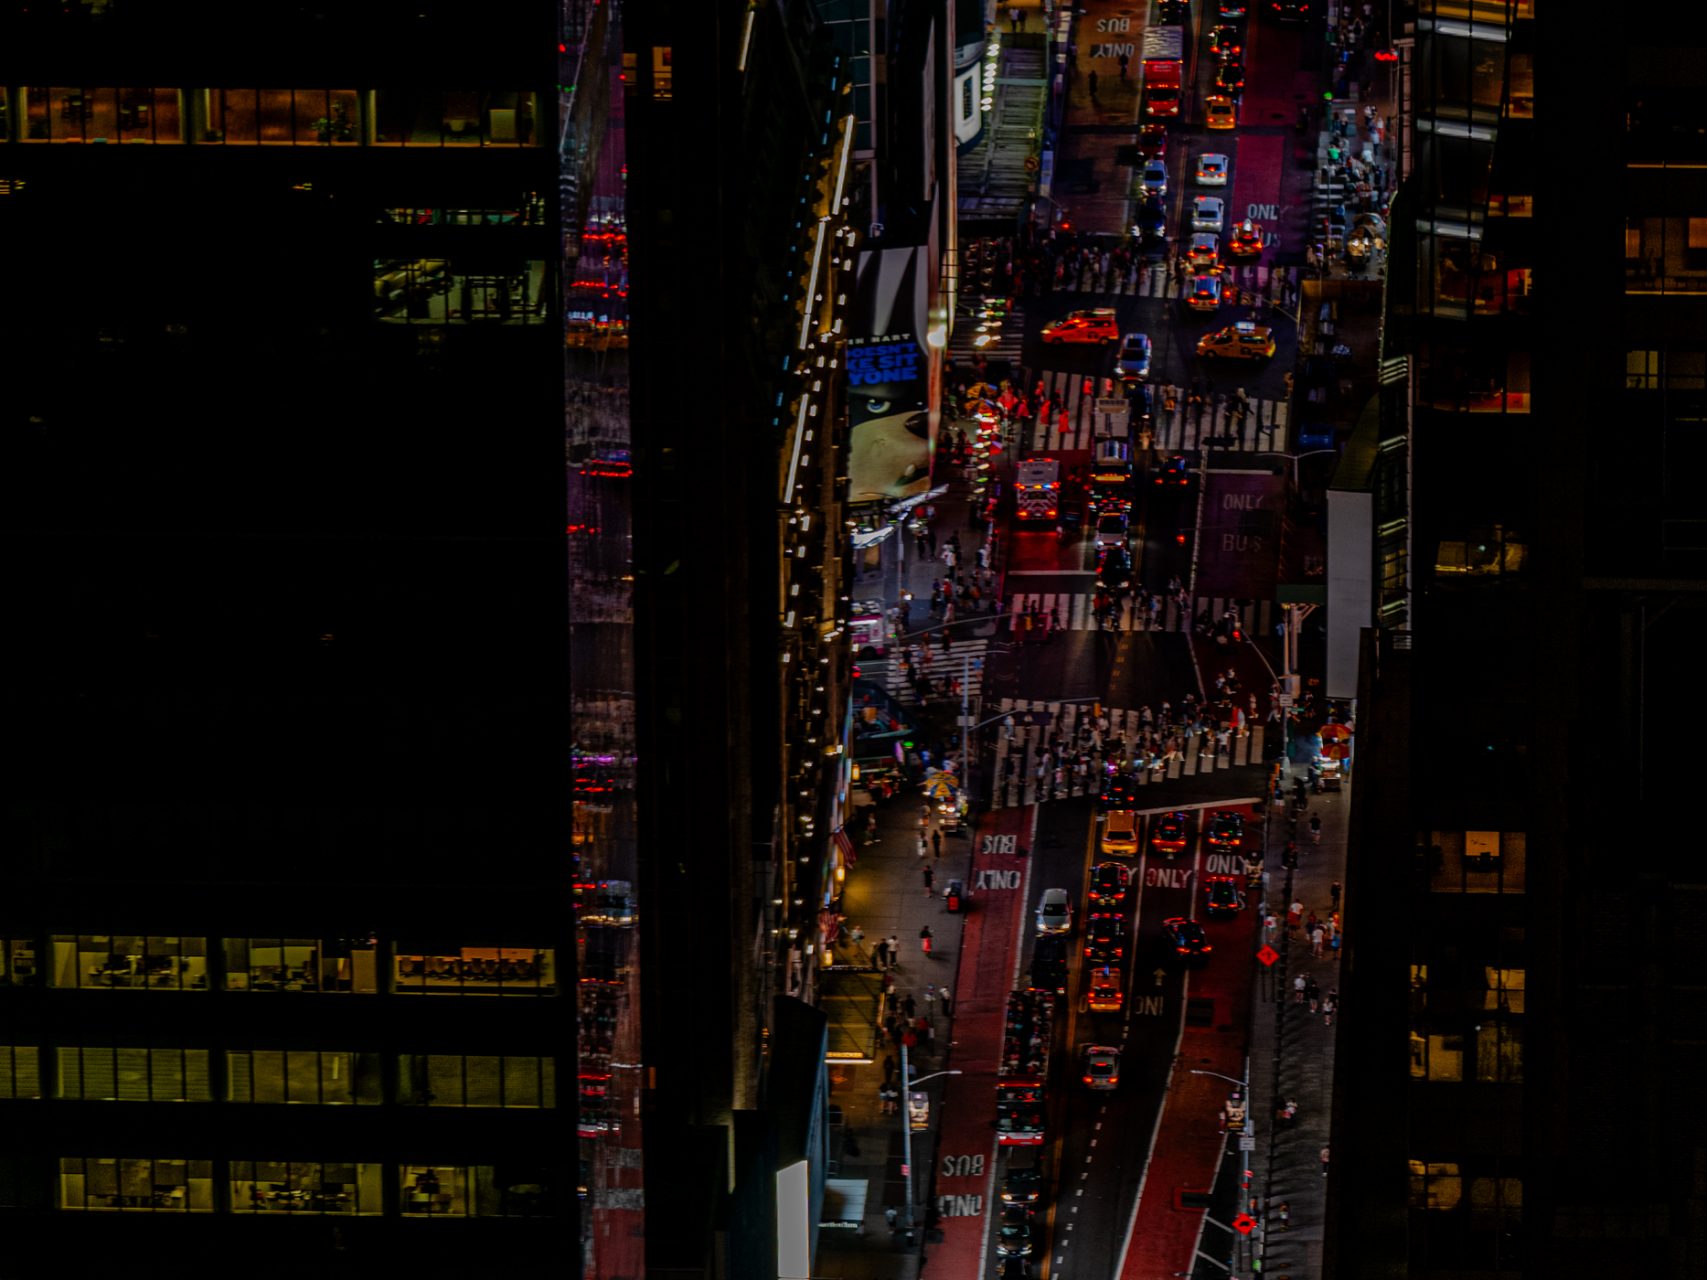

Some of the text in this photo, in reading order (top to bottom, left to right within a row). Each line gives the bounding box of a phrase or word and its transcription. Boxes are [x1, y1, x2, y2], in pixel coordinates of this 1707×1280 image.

[1096, 18, 1131, 33] BUS
[1093, 43, 1135, 59] ONLY
[1223, 493, 1264, 512] ONLY
[982, 834, 1018, 855] BUS
[975, 869, 1021, 890] ONLY
[1145, 867, 1193, 889] ONLY
[942, 1154, 985, 1176] BUS
